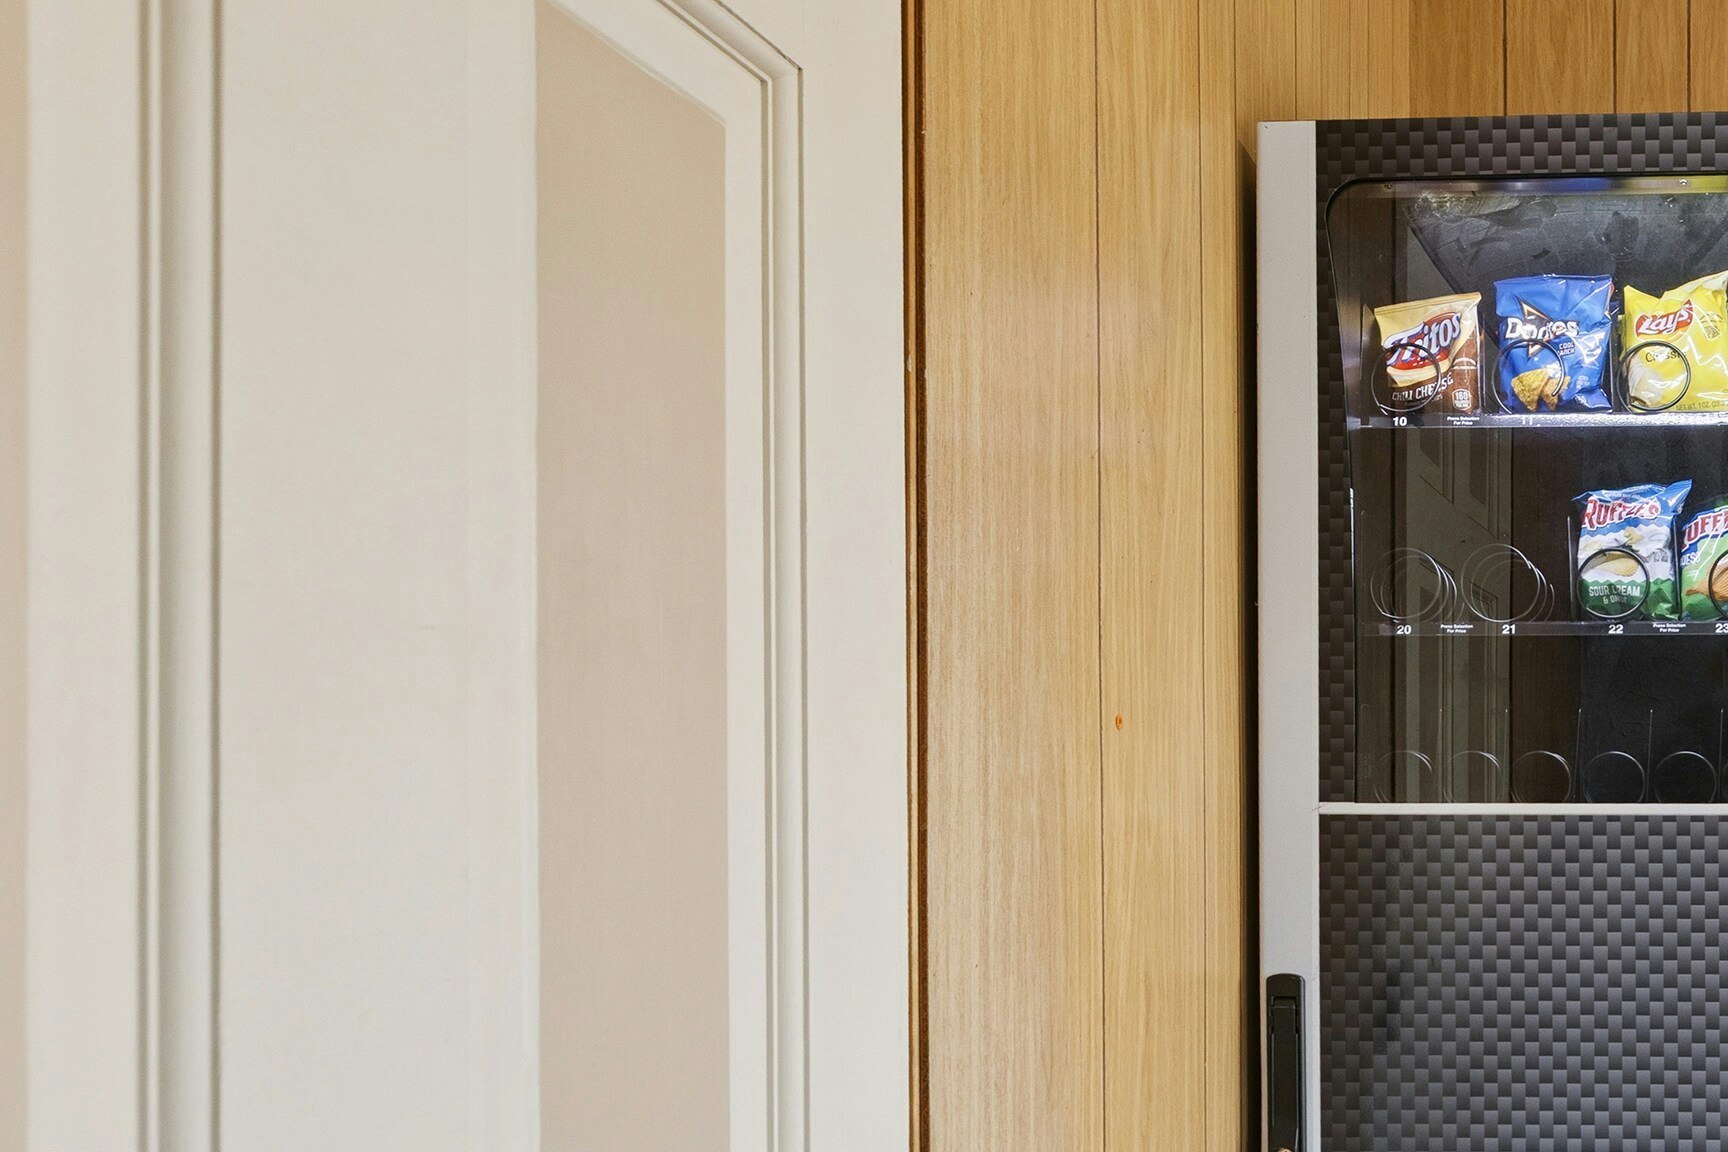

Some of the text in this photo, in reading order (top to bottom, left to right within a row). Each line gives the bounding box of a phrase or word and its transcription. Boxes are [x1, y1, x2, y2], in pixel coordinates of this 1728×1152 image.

[1415, 372, 1454, 400] CHESE
[1392, 417, 1408, 427] 10
[1588, 585, 1610, 597] SOUR
[1397, 625, 1412, 635] 20
[1502, 625, 1516, 635] 21
[1608, 624, 1624, 634] 22
